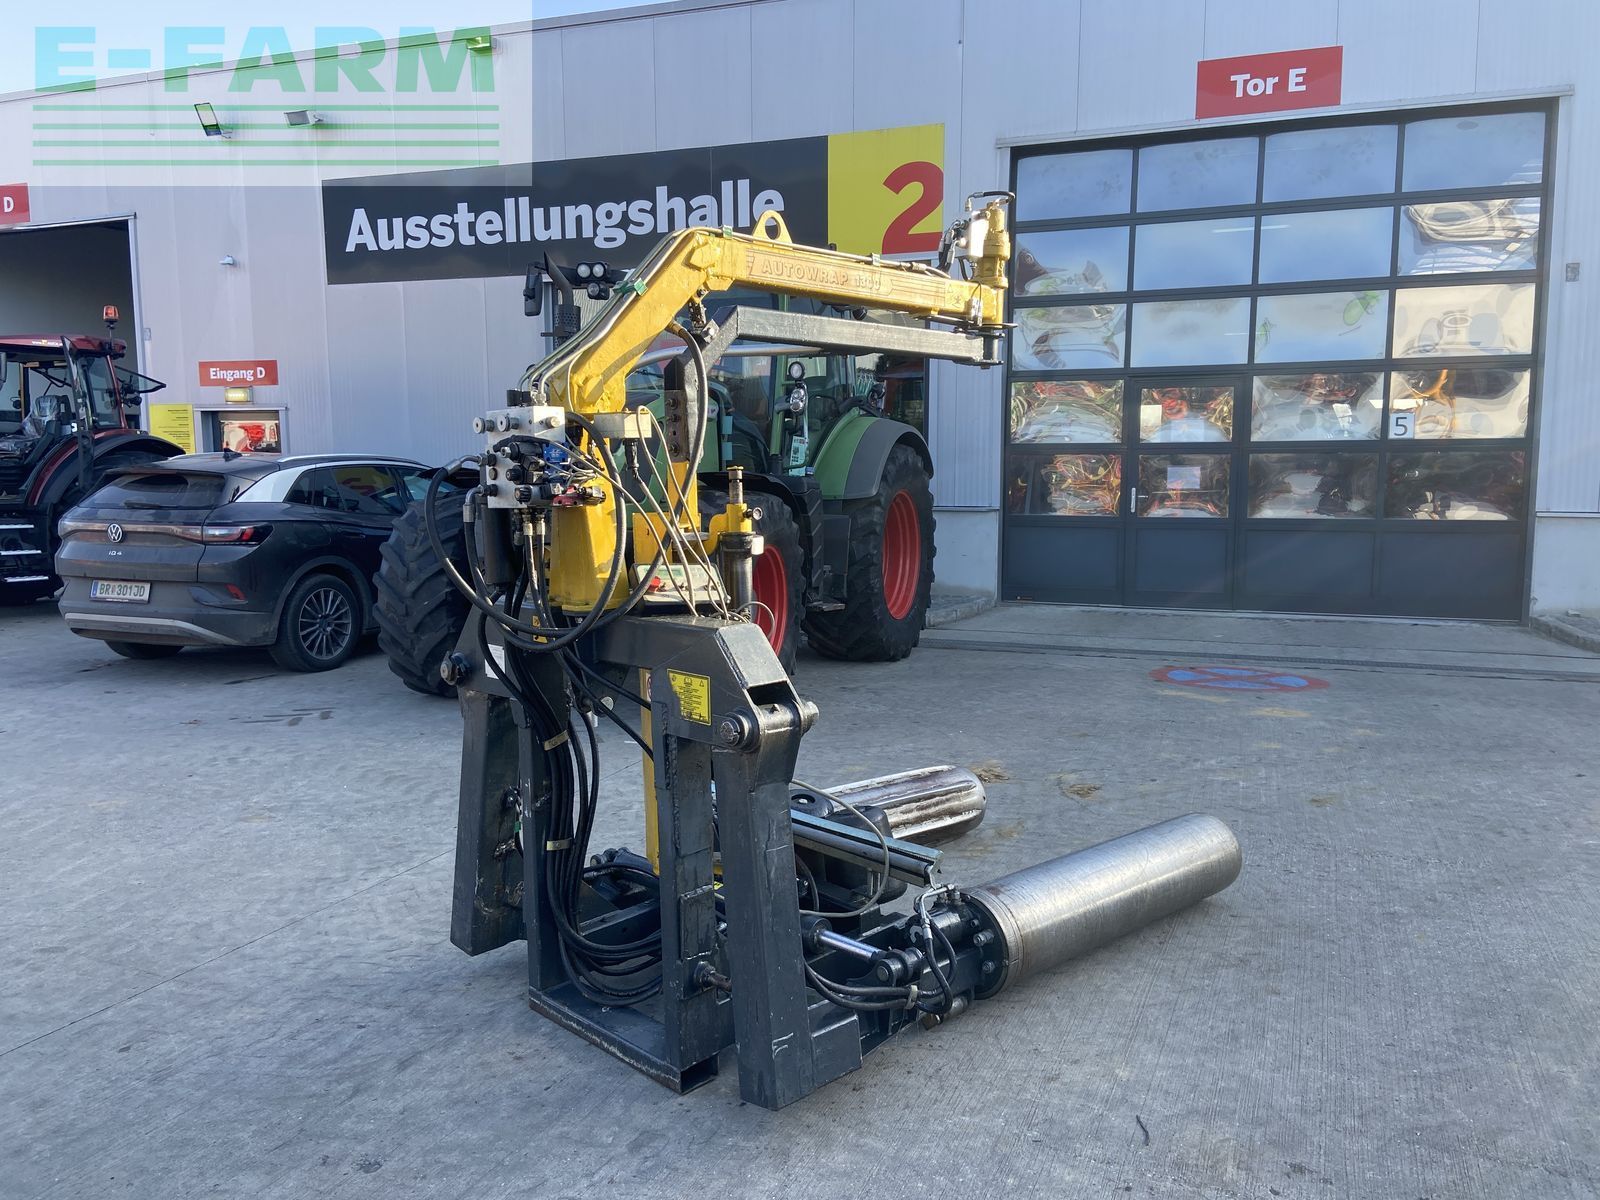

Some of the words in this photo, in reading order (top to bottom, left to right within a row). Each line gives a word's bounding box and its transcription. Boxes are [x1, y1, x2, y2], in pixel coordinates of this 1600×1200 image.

[1230, 73, 1279, 98] Tor
[1288, 67, 1307, 93] E
[3, 196, 15, 213] D
[345, 178, 785, 253] Ausstellungshalle
[881, 160, 944, 255] 2
[762, 259, 849, 286] AUTOWRAP
[209, 367, 255, 382] Eingang
[256, 366, 266, 379] D
[1393, 416, 1408, 437] 5
